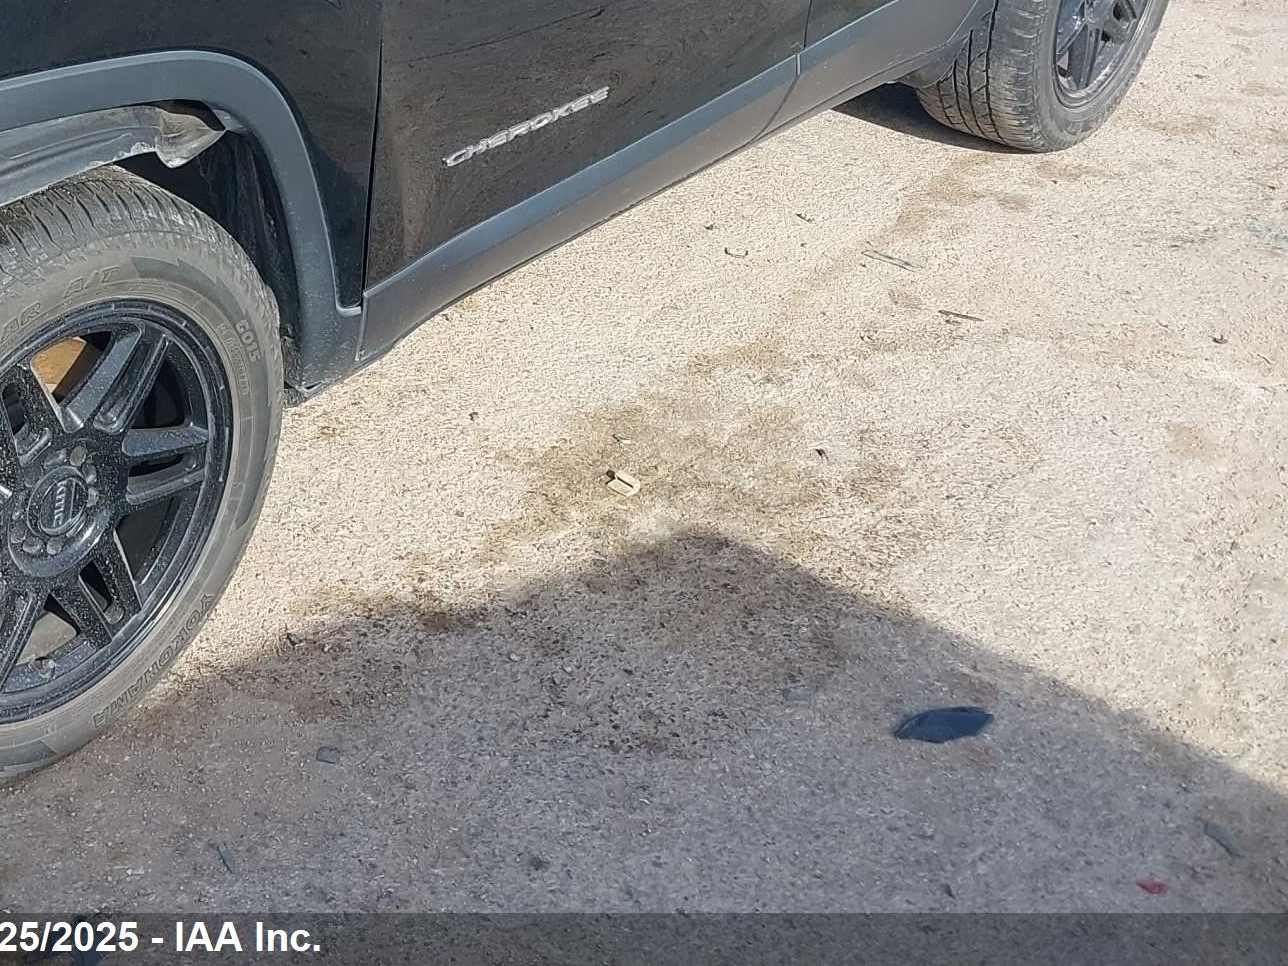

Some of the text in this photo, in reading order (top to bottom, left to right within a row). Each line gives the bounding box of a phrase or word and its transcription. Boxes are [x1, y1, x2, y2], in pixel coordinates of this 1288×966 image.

[441, 85, 610, 167] CHEROKEE
[63, 264, 120, 299] A/T
[234, 318, 263, 363] G015
[92, 593, 216, 728] YOKOHAMA
